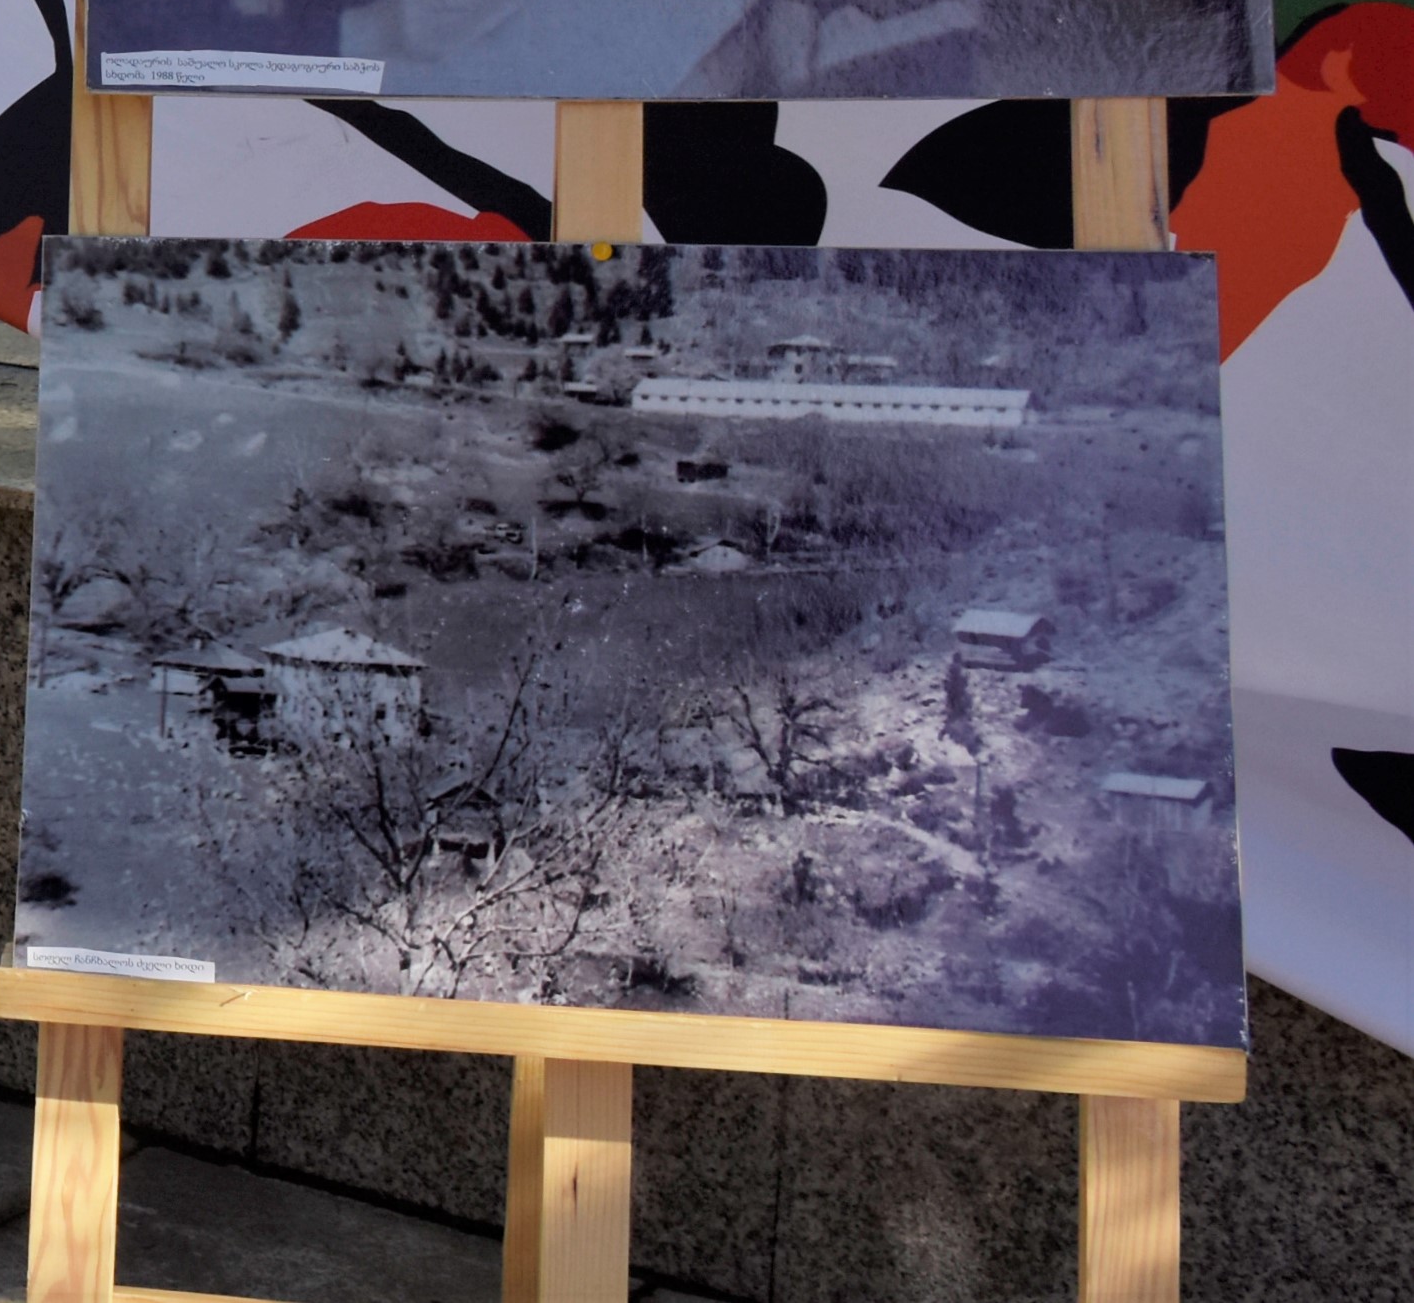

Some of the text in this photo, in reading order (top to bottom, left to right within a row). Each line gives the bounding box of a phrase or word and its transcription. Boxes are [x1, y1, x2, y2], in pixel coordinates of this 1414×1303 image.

[105, 56, 380, 74] ოლადაურის საშუალო სკოლა პედაგოგიური საბჭოს
[105, 69, 205, 83] სხდომა 1988 წელი
[136, 958, 171, 972] ძველი
